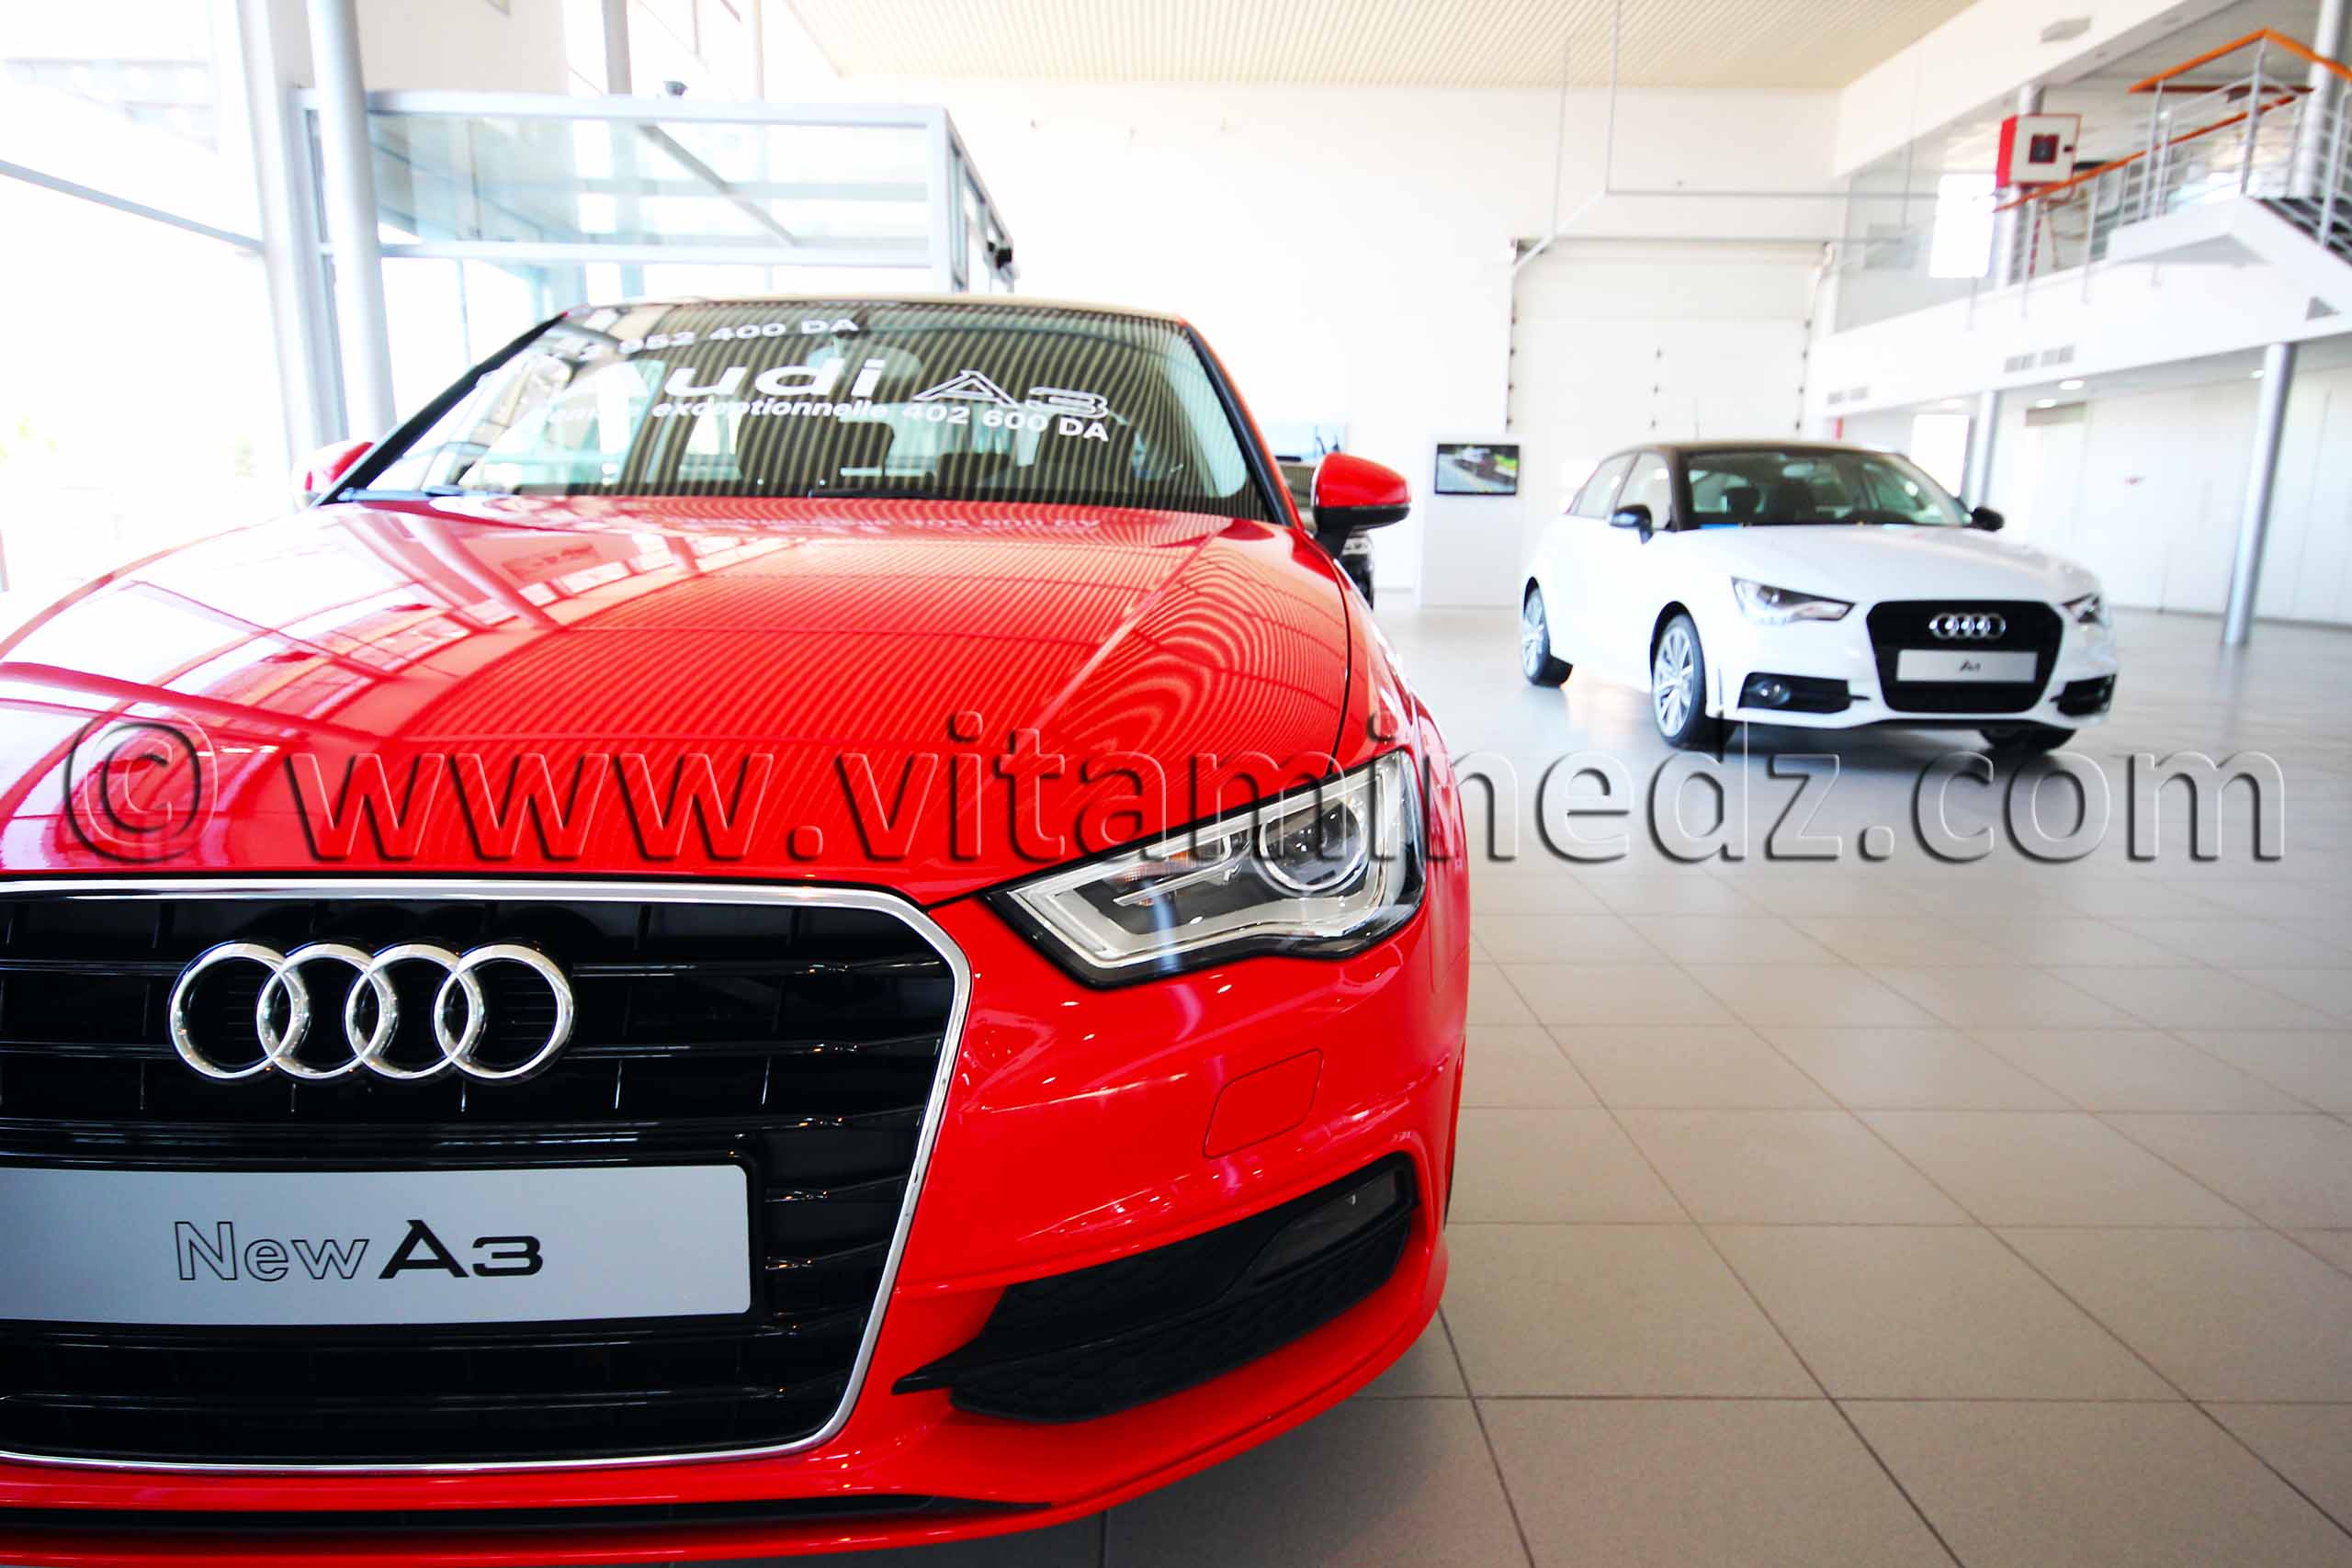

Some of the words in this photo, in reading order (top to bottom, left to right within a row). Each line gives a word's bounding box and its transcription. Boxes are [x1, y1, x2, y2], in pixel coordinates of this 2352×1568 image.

[709, 322, 786, 341] 400
[801, 319, 858, 334] DA
[911, 369, 1111, 419] A3
[901, 404, 971, 425] 402
[982, 410, 1049, 433] 600
[1057, 417, 1110, 442] DA
[175, 1221, 369, 1282] New
[378, 1219, 544, 1279] A3
